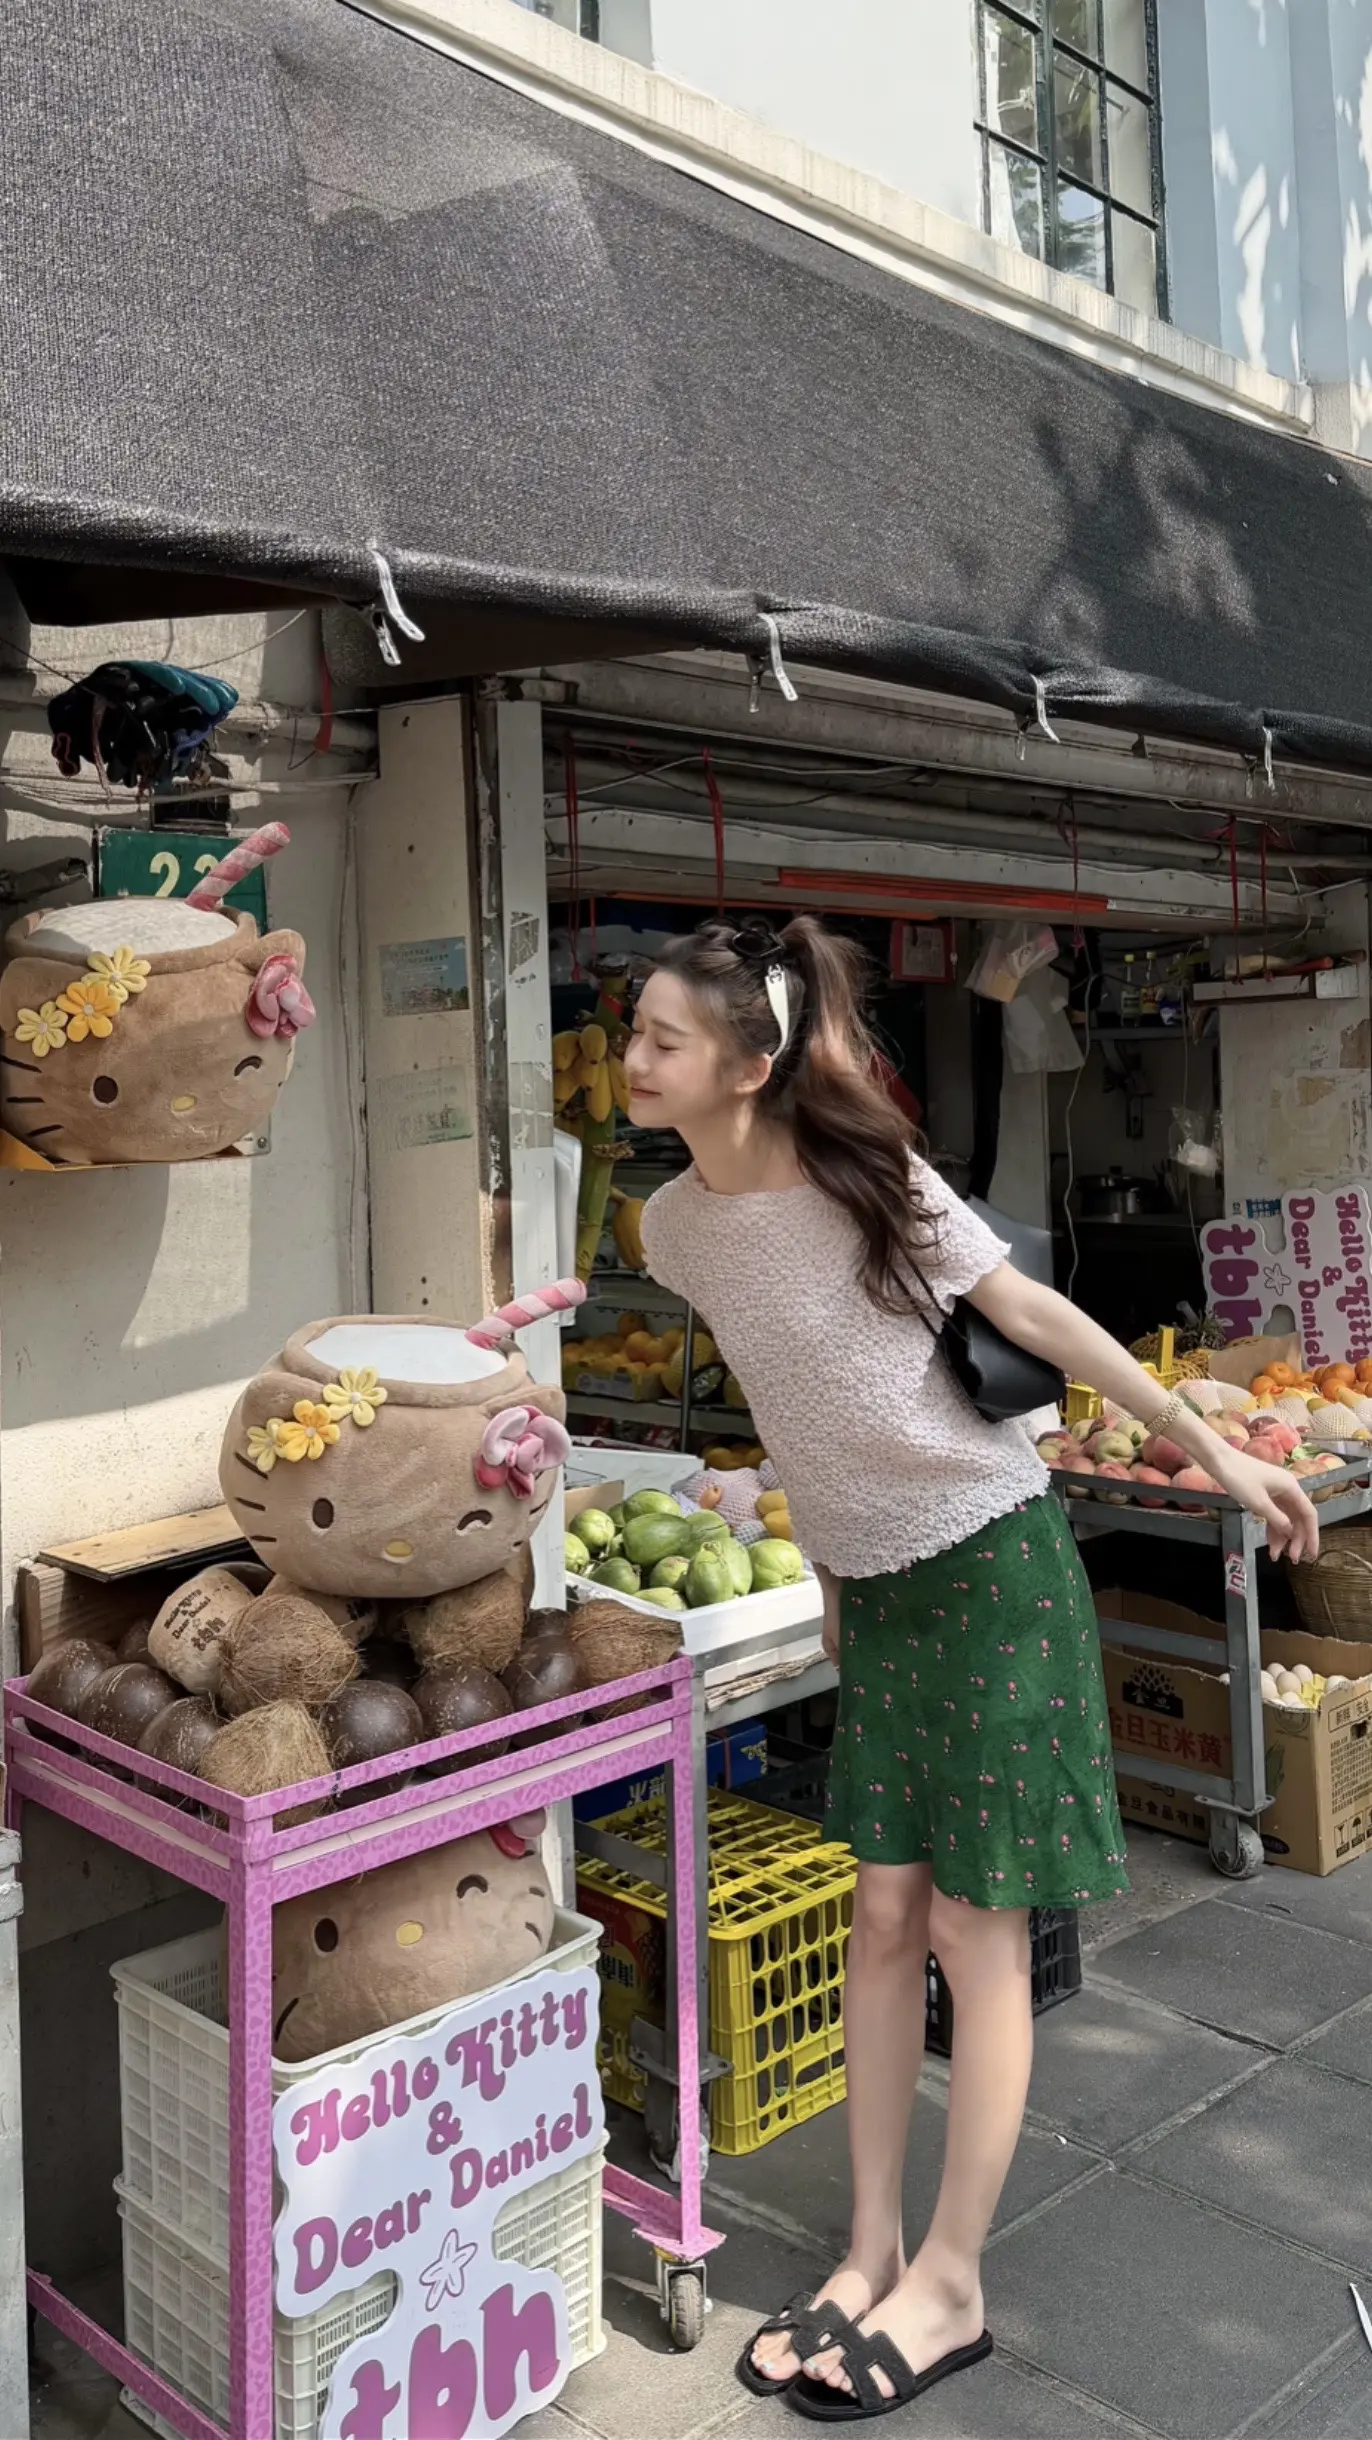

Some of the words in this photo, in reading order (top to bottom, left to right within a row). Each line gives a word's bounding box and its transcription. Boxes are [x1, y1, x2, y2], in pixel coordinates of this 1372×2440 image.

[1288, 1196, 1316, 1270] Dear
[1322, 1265, 1343, 1288] &
[1335, 1192, 1366, 1273] Hello
[1206, 1223, 1262, 1341] tbh
[1297, 1279, 1330, 1368] Daniel
[1335, 1275, 1372, 1365] Kitty
[290, 2056, 439, 2167] Hello
[445, 1987, 589, 2101] Kitty
[427, 2101, 463, 2156] &
[292, 2189, 432, 2294] Dear
[449, 2083, 593, 2209] Daniel
[340, 2283, 560, 2440] tbh
